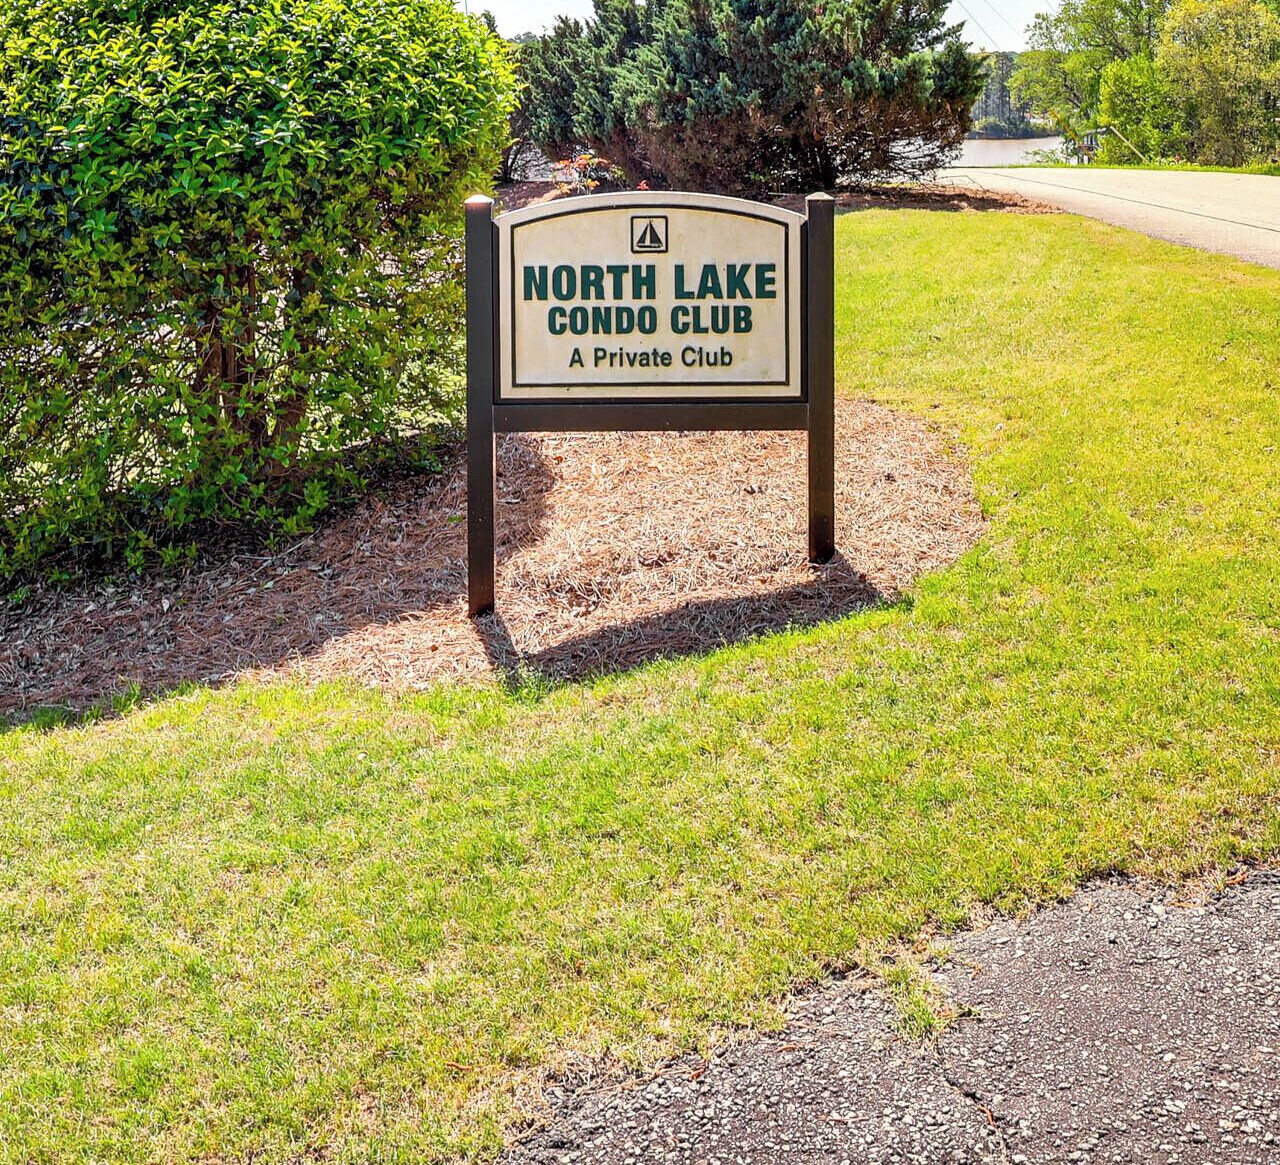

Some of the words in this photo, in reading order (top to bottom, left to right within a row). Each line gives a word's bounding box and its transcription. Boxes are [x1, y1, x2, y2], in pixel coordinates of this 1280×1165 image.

[523, 264, 657, 301] NORTH
[674, 263, 777, 300] LAKE
[547, 305, 658, 336] CONDO
[670, 304, 753, 335] CLUB
[568, 347, 585, 368] A
[593, 347, 673, 368] Private
[681, 345, 733, 368] Club
